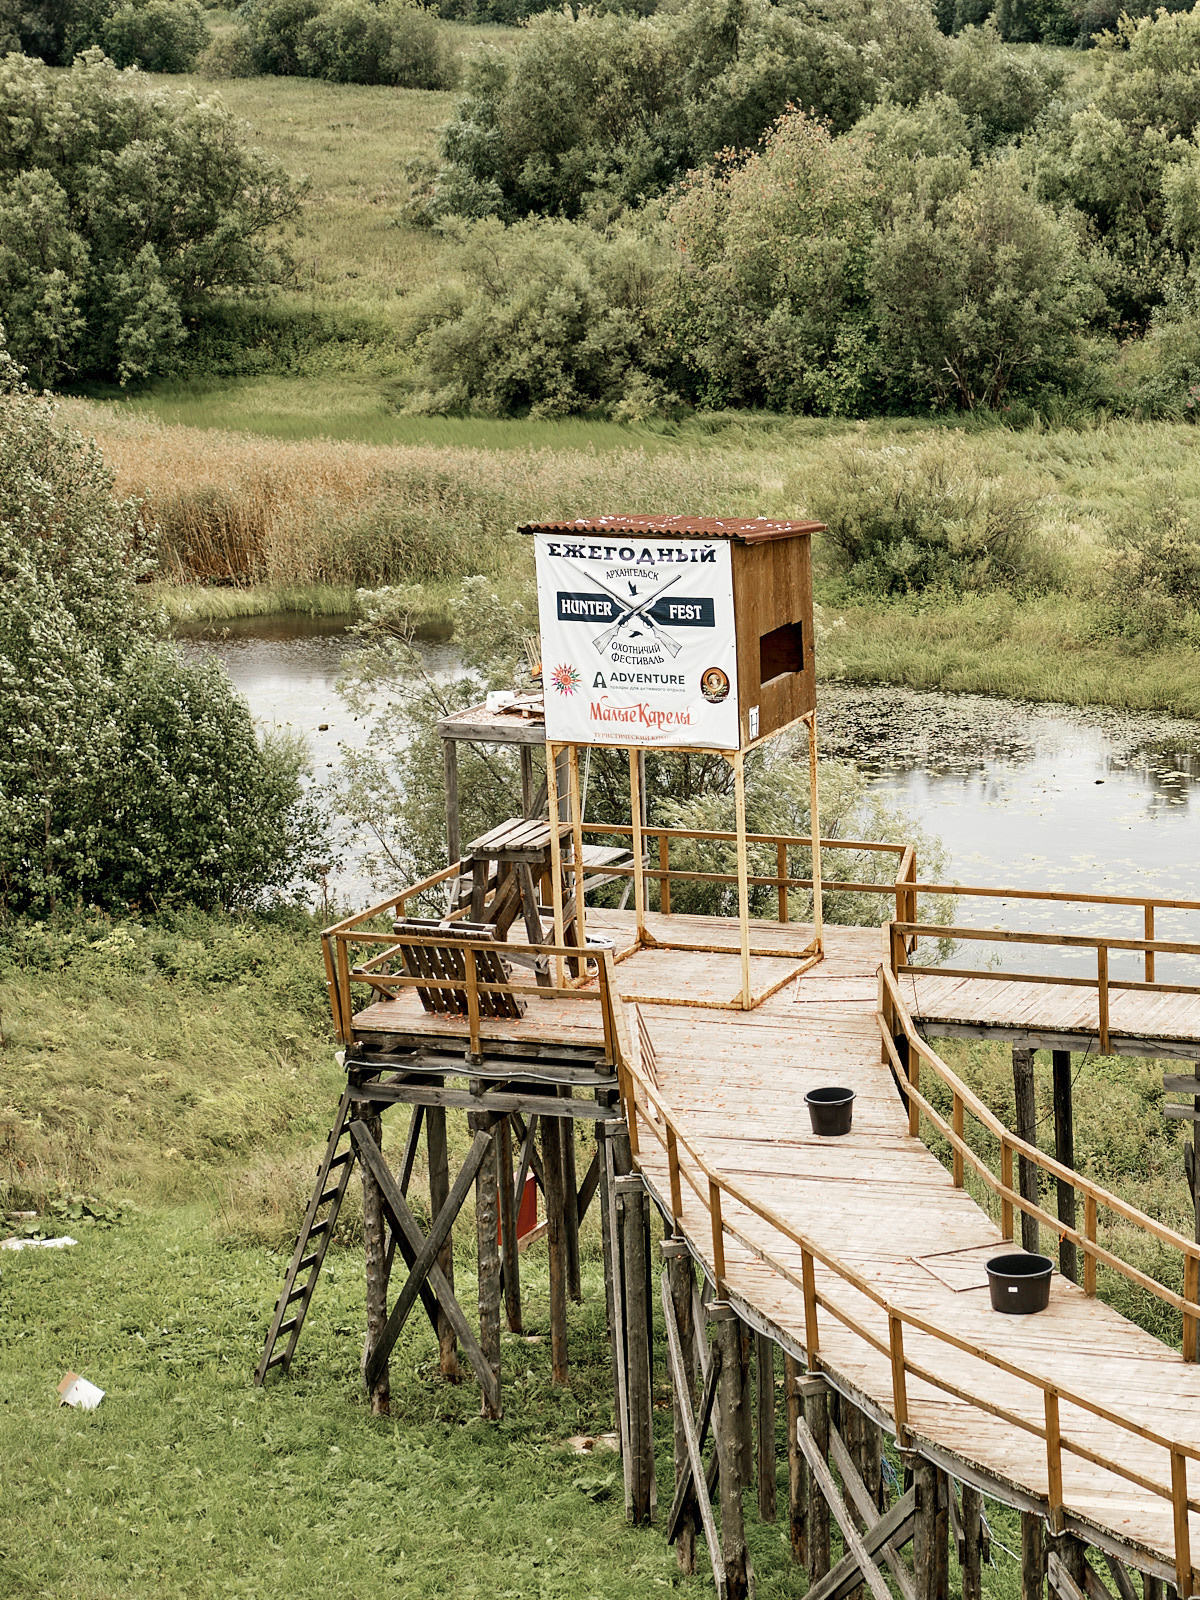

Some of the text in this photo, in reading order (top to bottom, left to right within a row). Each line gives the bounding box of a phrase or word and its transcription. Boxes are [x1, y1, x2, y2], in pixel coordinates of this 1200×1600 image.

[547, 543, 717, 565] ЕЖЕГОДНЫЙ
[606, 568, 659, 581] АРХАНГЕЛЬСК
[561, 599, 702, 620] HUNTER FEST
[611, 641, 661, 655] ОХОТНИЧИЙ
[611, 652, 665, 666] ФЕСТИВАЛЬ
[610, 672, 686, 686] ADVENTURE
[590, 702, 694, 731] Малые Карелы
